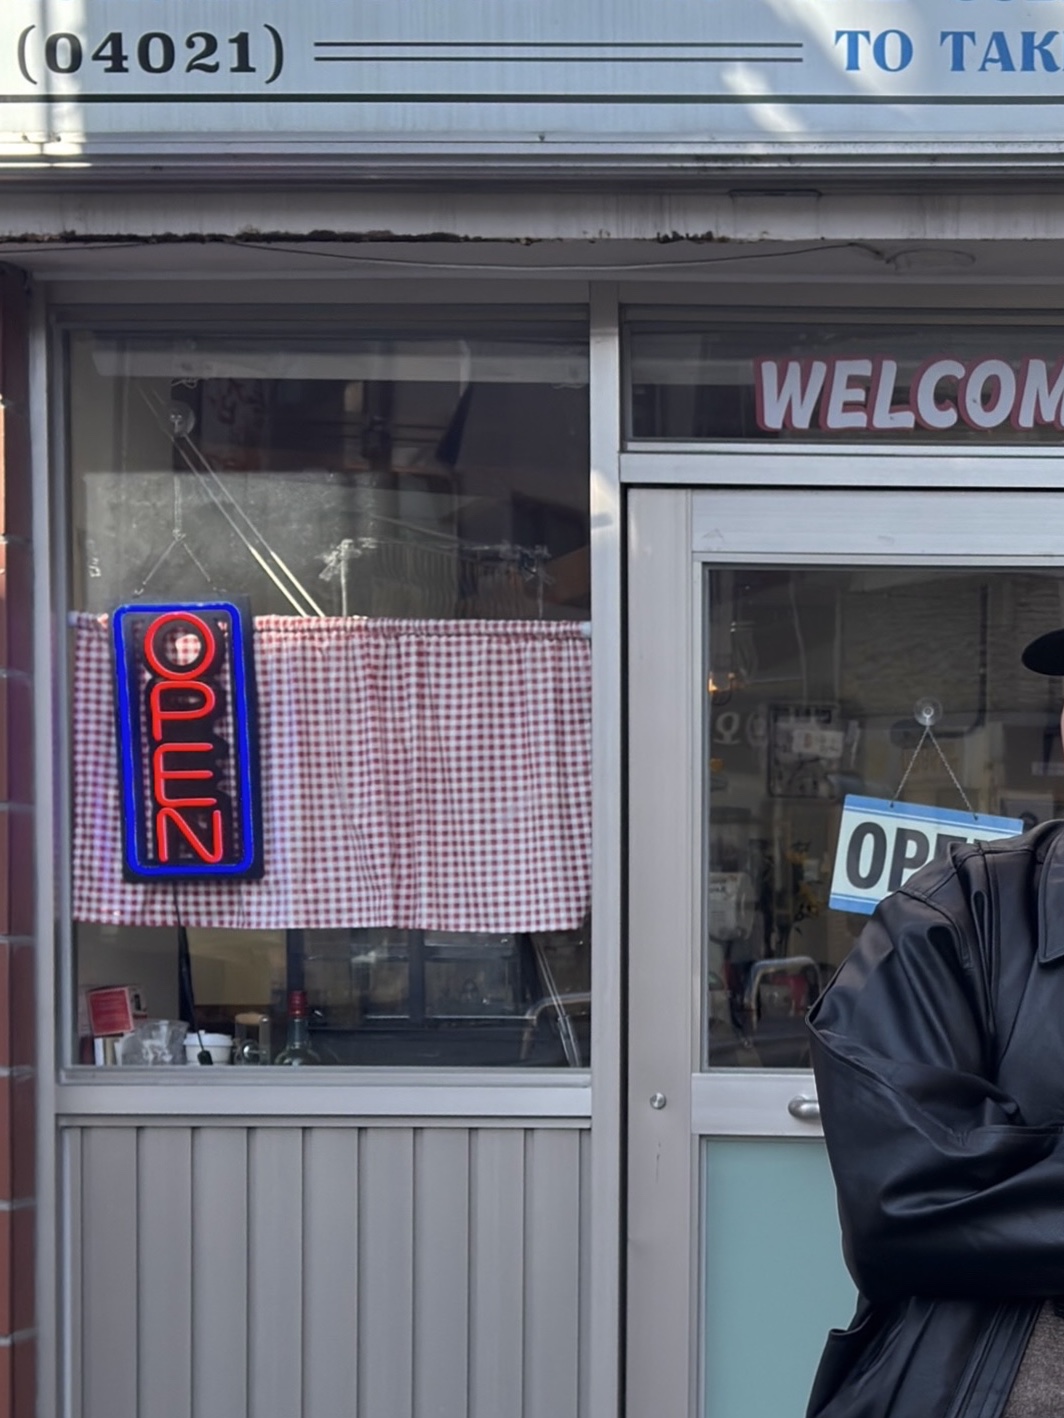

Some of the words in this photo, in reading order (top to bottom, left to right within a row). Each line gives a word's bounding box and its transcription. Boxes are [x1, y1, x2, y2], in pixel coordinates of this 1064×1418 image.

[18, 24, 284, 85] (04021)
[834, 29, 914, 72] TO
[144, 612, 223, 863] OPEN
[846, 821, 990, 892] OP
